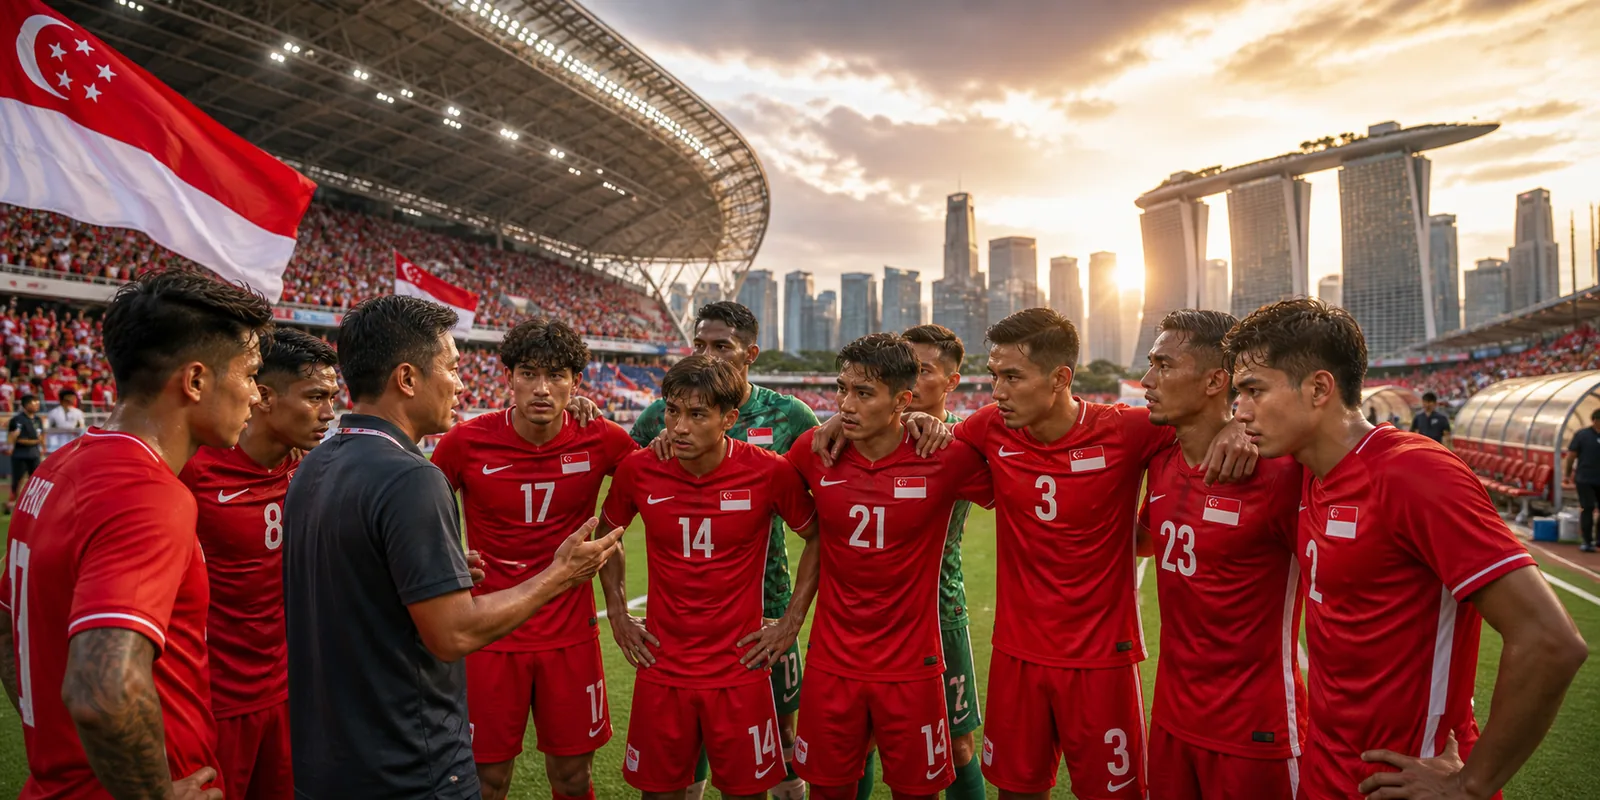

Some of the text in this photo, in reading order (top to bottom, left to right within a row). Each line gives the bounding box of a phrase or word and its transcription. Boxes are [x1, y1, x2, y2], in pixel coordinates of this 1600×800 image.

[520, 481, 556, 523] 17
[1034, 475, 1058, 521] 3
[264, 502, 283, 550] 8
[678, 517, 715, 558] 14
[849, 504, 885, 549] 21
[1160, 520, 1197, 577] 23
[1305, 539, 1323, 604] 2
[748, 718, 776, 766] 14
[1104, 728, 1130, 776] 3
